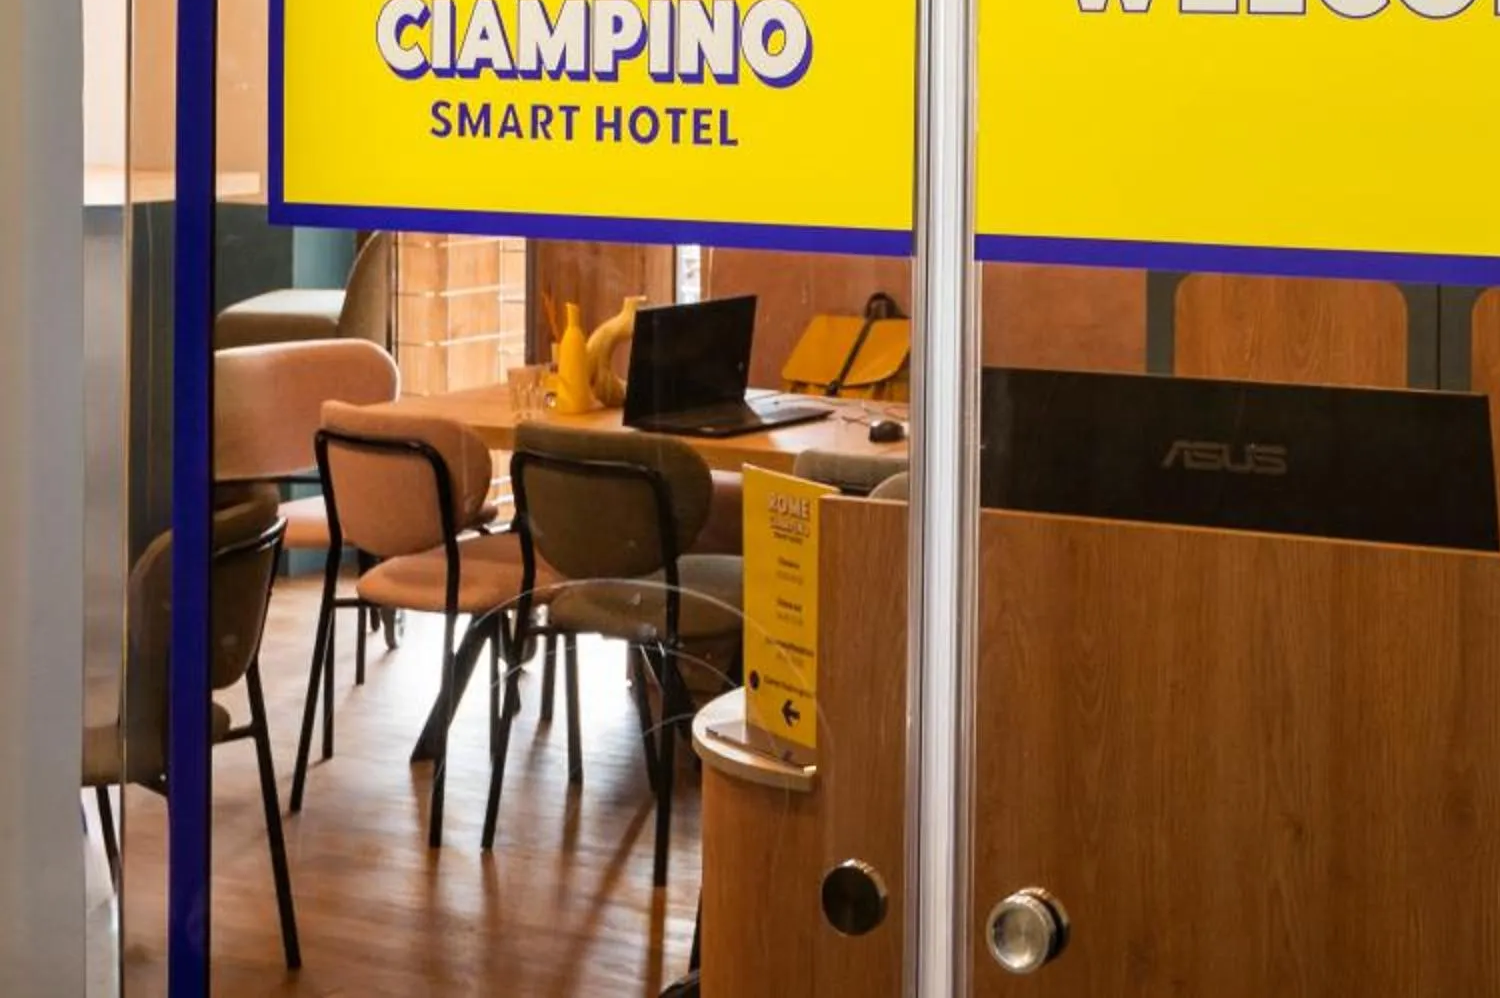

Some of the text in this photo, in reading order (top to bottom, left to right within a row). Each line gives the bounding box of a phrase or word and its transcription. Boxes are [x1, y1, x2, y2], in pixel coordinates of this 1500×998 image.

[430, 100, 738, 146] SMART HOTEL
[1161, 440, 1287, 475] ASUS
